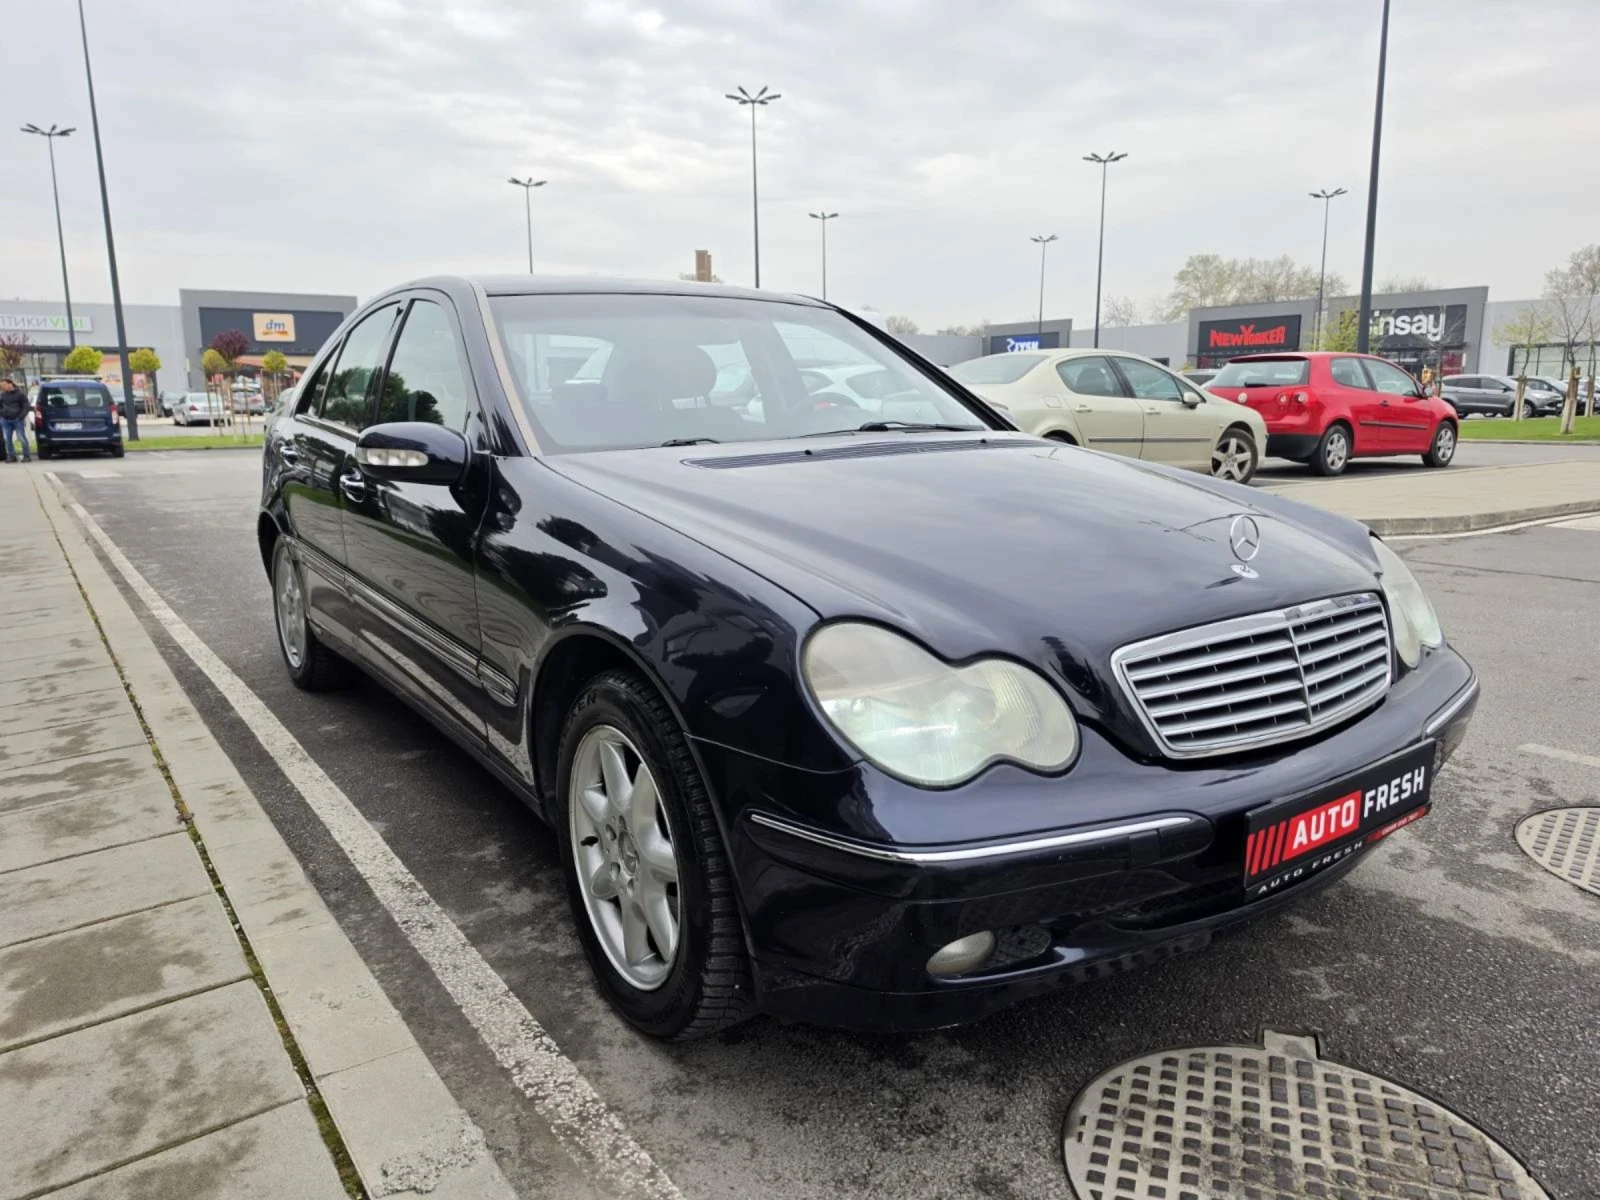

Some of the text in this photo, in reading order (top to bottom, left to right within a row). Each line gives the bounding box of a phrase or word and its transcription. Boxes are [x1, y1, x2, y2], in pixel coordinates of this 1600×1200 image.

[265, 319, 286, 330] dm
[1369, 310, 1446, 342] insay
[1292, 798, 1356, 850] AUTO
[1363, 766, 1425, 818] FRESH
[1258, 841, 1363, 893] AUTO FRESH
